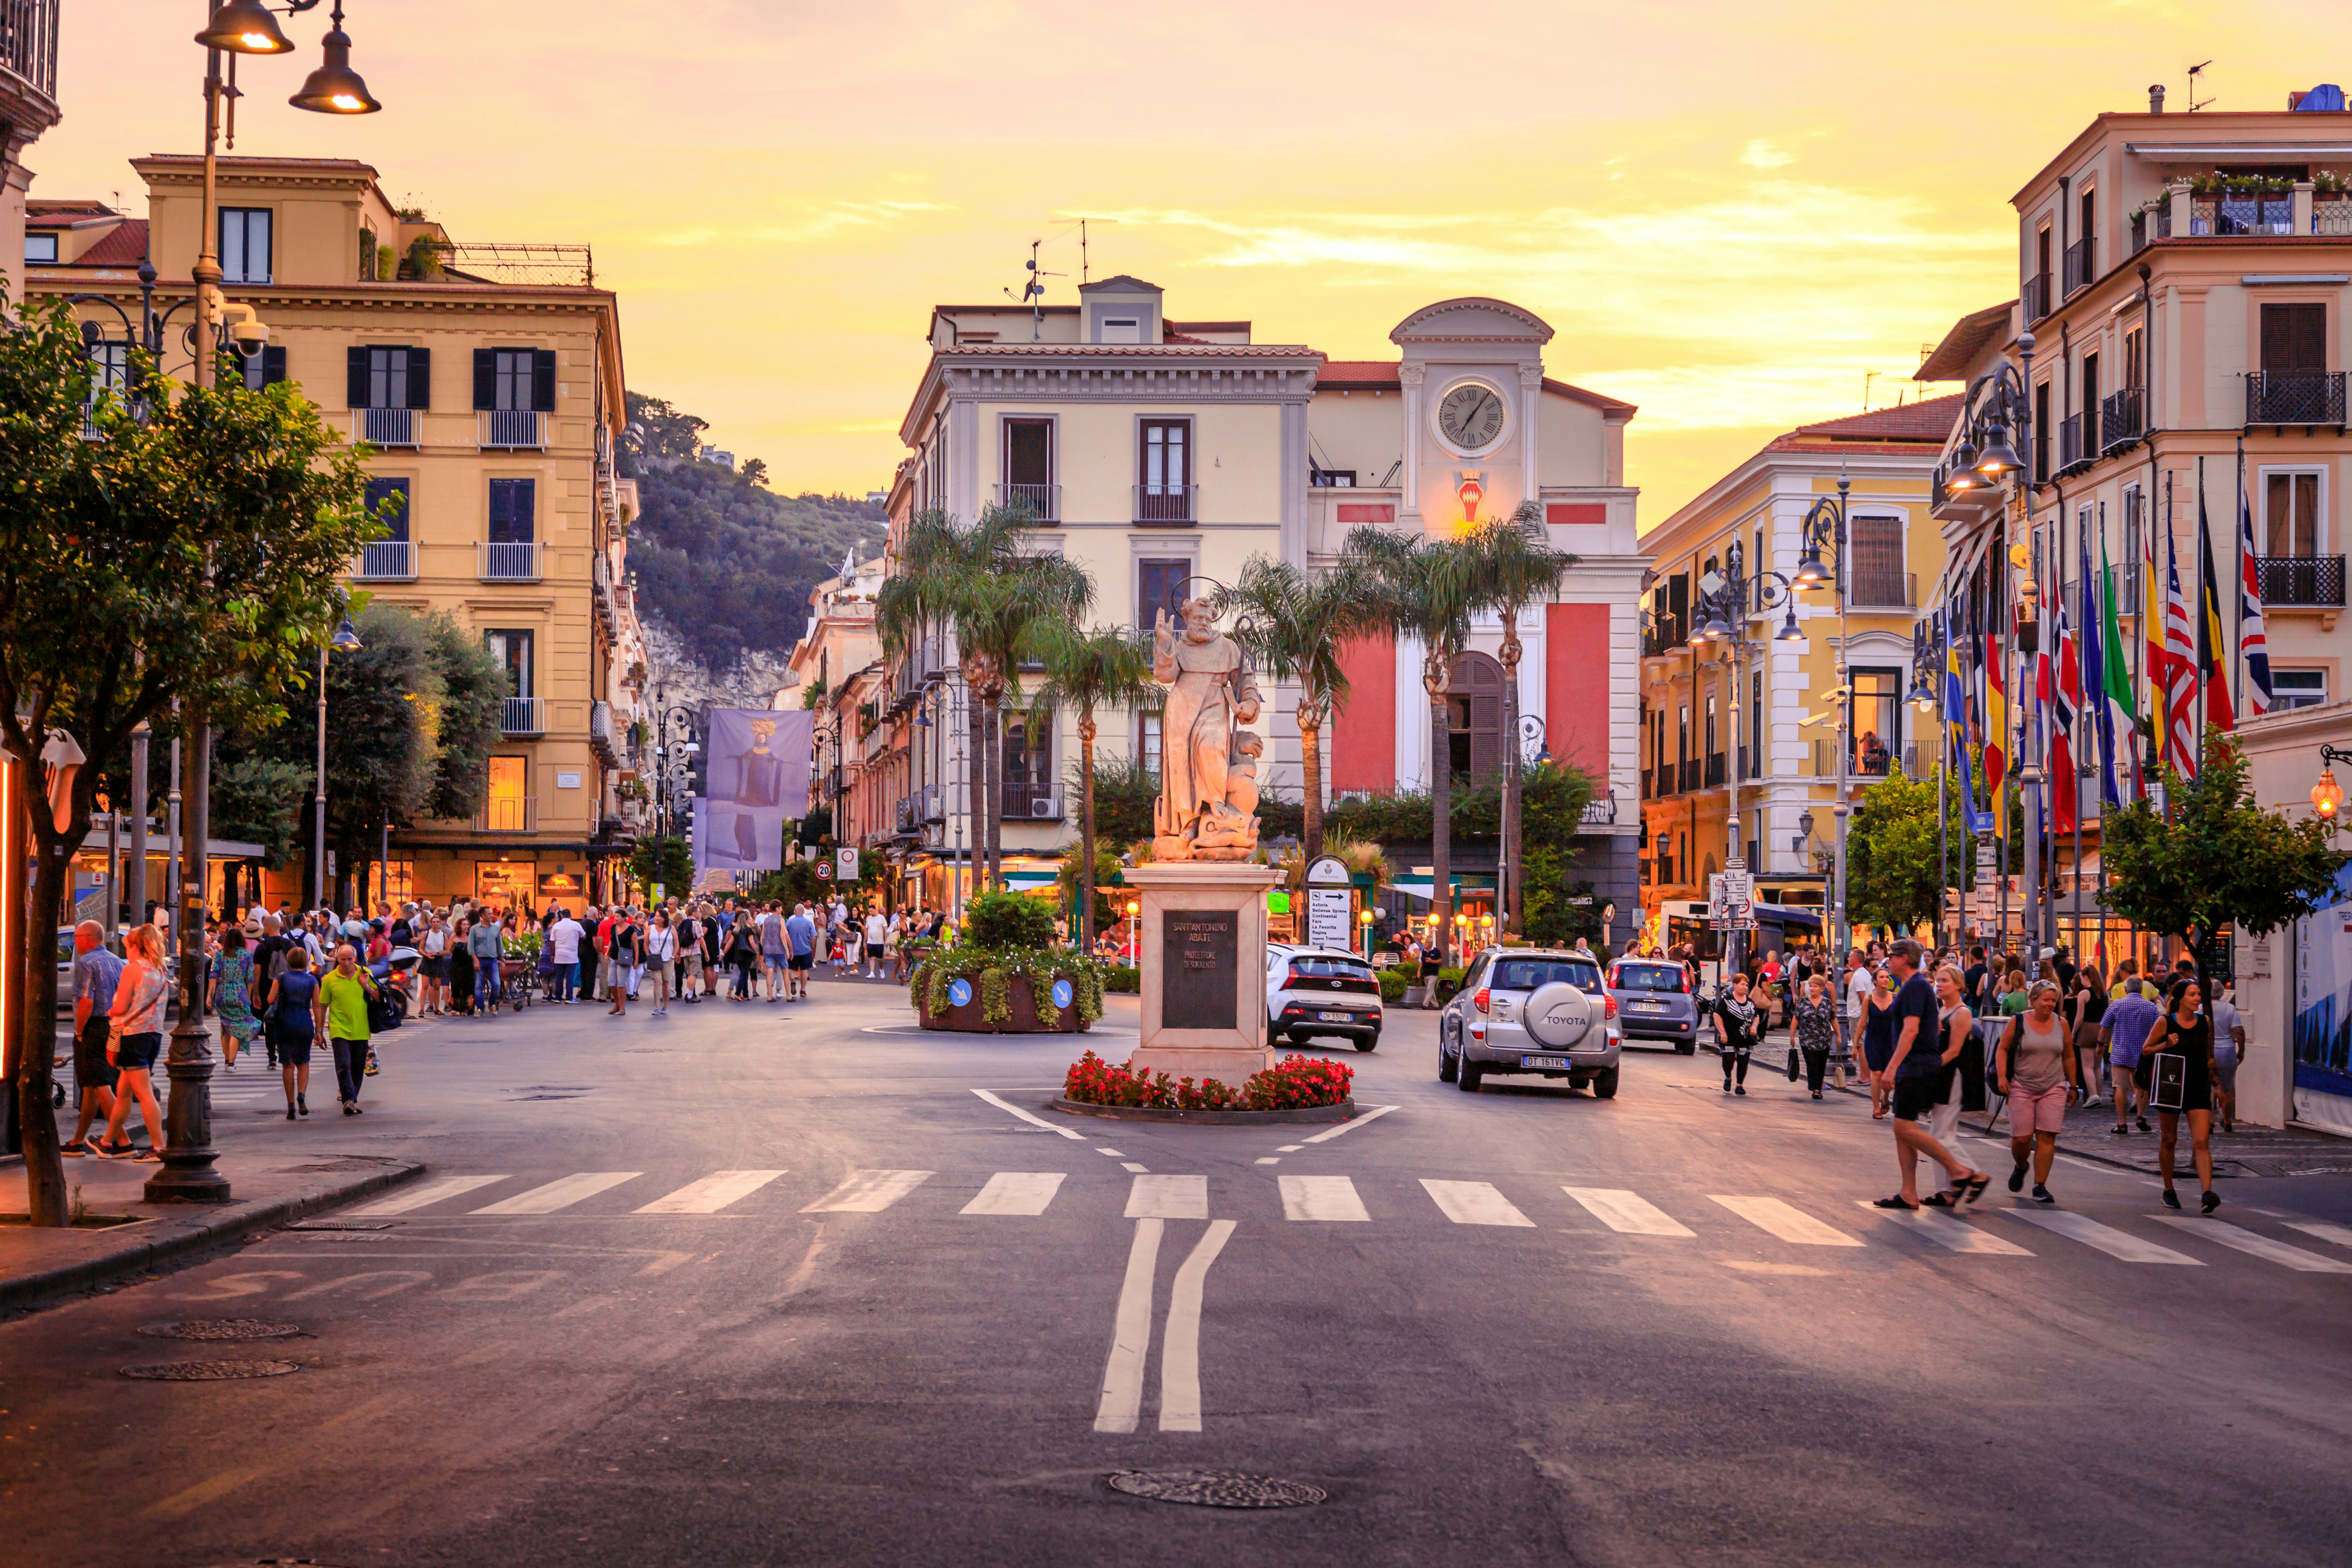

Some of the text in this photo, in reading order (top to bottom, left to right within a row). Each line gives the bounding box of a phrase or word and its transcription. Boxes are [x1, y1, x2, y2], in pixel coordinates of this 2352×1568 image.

[1455, 392, 1466, 404] XI
[1467, 390, 1477, 401] XII
[1447, 400, 1458, 410] X
[1484, 402, 1495, 411] II
[1468, 433, 1475, 444] VI
[1479, 431, 1487, 442] V
[820, 866, 829, 875] 20
[1189, 933, 1212, 942] ABATE
[1184, 951, 1216, 959] PROTETTORE
[1546, 1016, 1586, 1025] TOYOTA
[1542, 1058, 1564, 1067] 161VG
